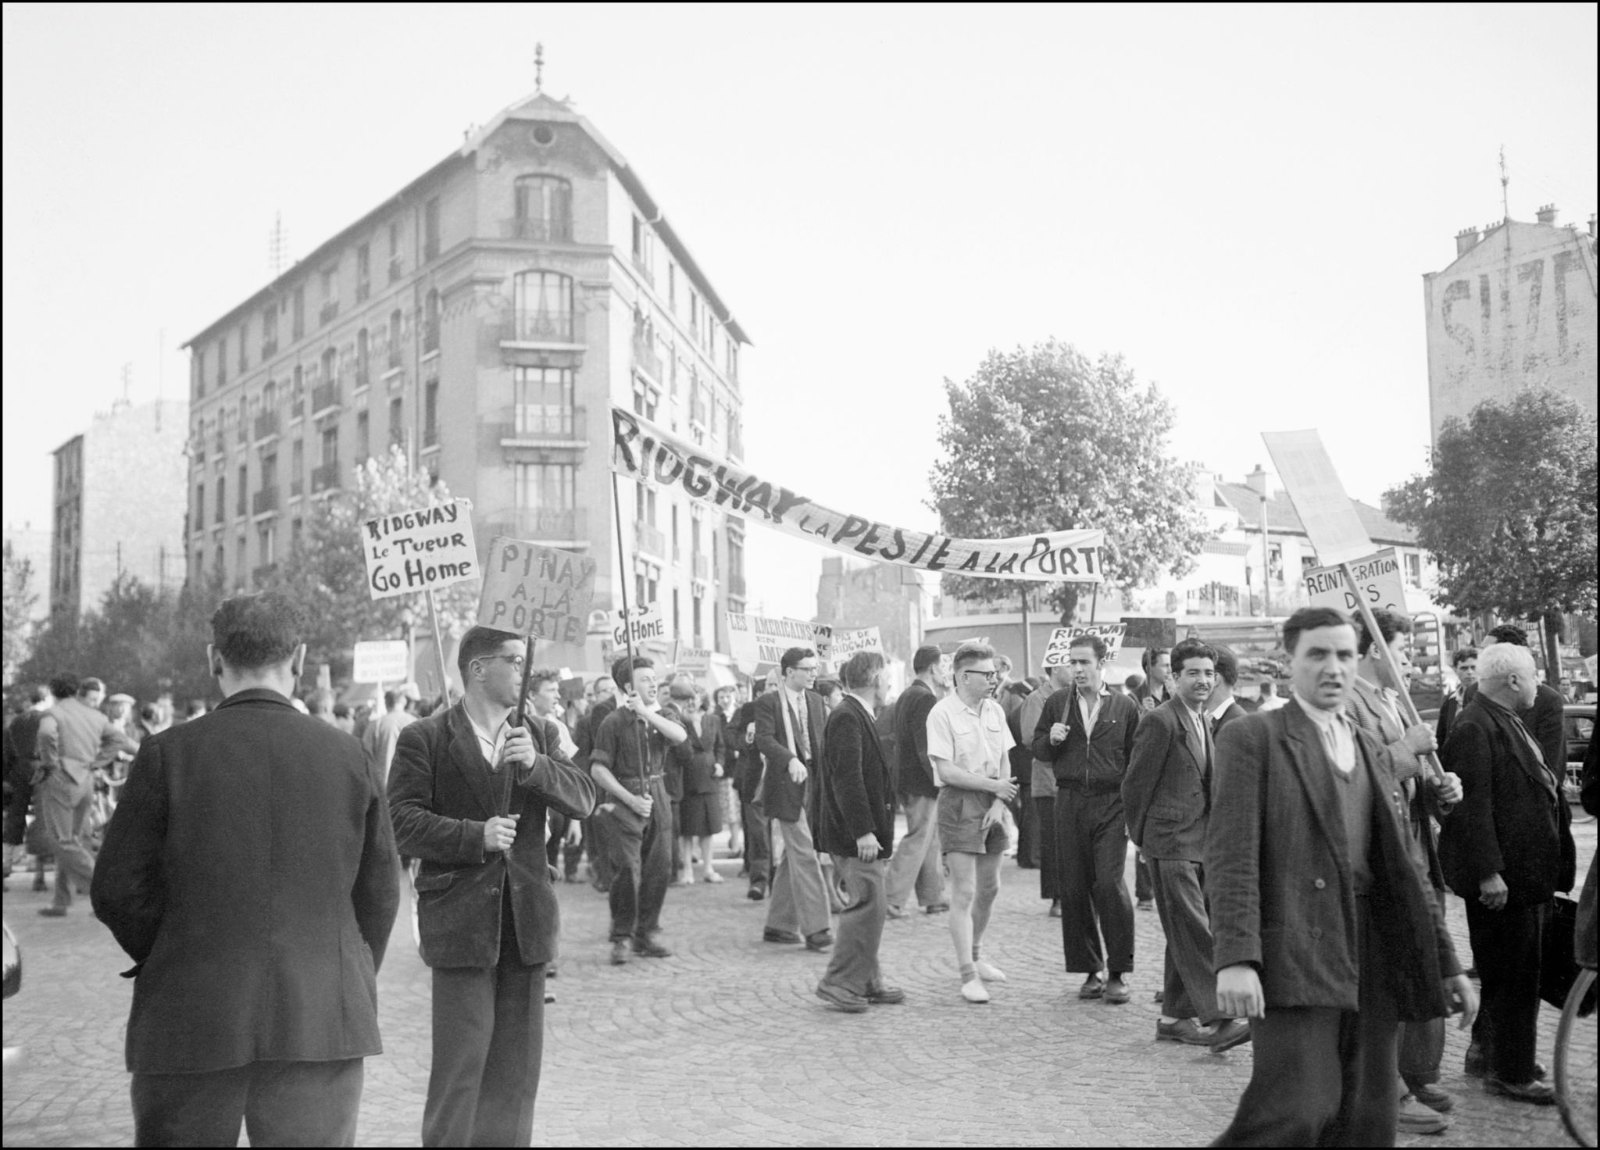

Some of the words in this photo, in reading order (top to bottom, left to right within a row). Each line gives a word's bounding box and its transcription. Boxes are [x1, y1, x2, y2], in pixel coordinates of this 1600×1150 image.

[612, 408, 812, 524] RIDGWAY
[800, 515, 829, 538] LA
[959, 551, 980, 570] A
[984, 552, 1019, 573] LA
[366, 503, 457, 540] RIDGWAY
[372, 546, 389, 559] Le
[372, 565, 401, 592] Go
[405, 559, 472, 587] Home
[500, 544, 597, 590] PINAY
[1306, 559, 1399, 596] REINTGRATION
[1344, 584, 1381, 609] DS
[490, 600, 580, 642] PORTE
[631, 619, 665, 641] HOME
[729, 612, 748, 631] LES
[755, 616, 813, 641] AMERICAINS
[1054, 625, 1127, 639] RIDGWAY
[755, 635, 776, 644] EN
[832, 637, 877, 655] RIDGWAY
[835, 632, 851, 643] PAS
[857, 630, 869, 639] DE
